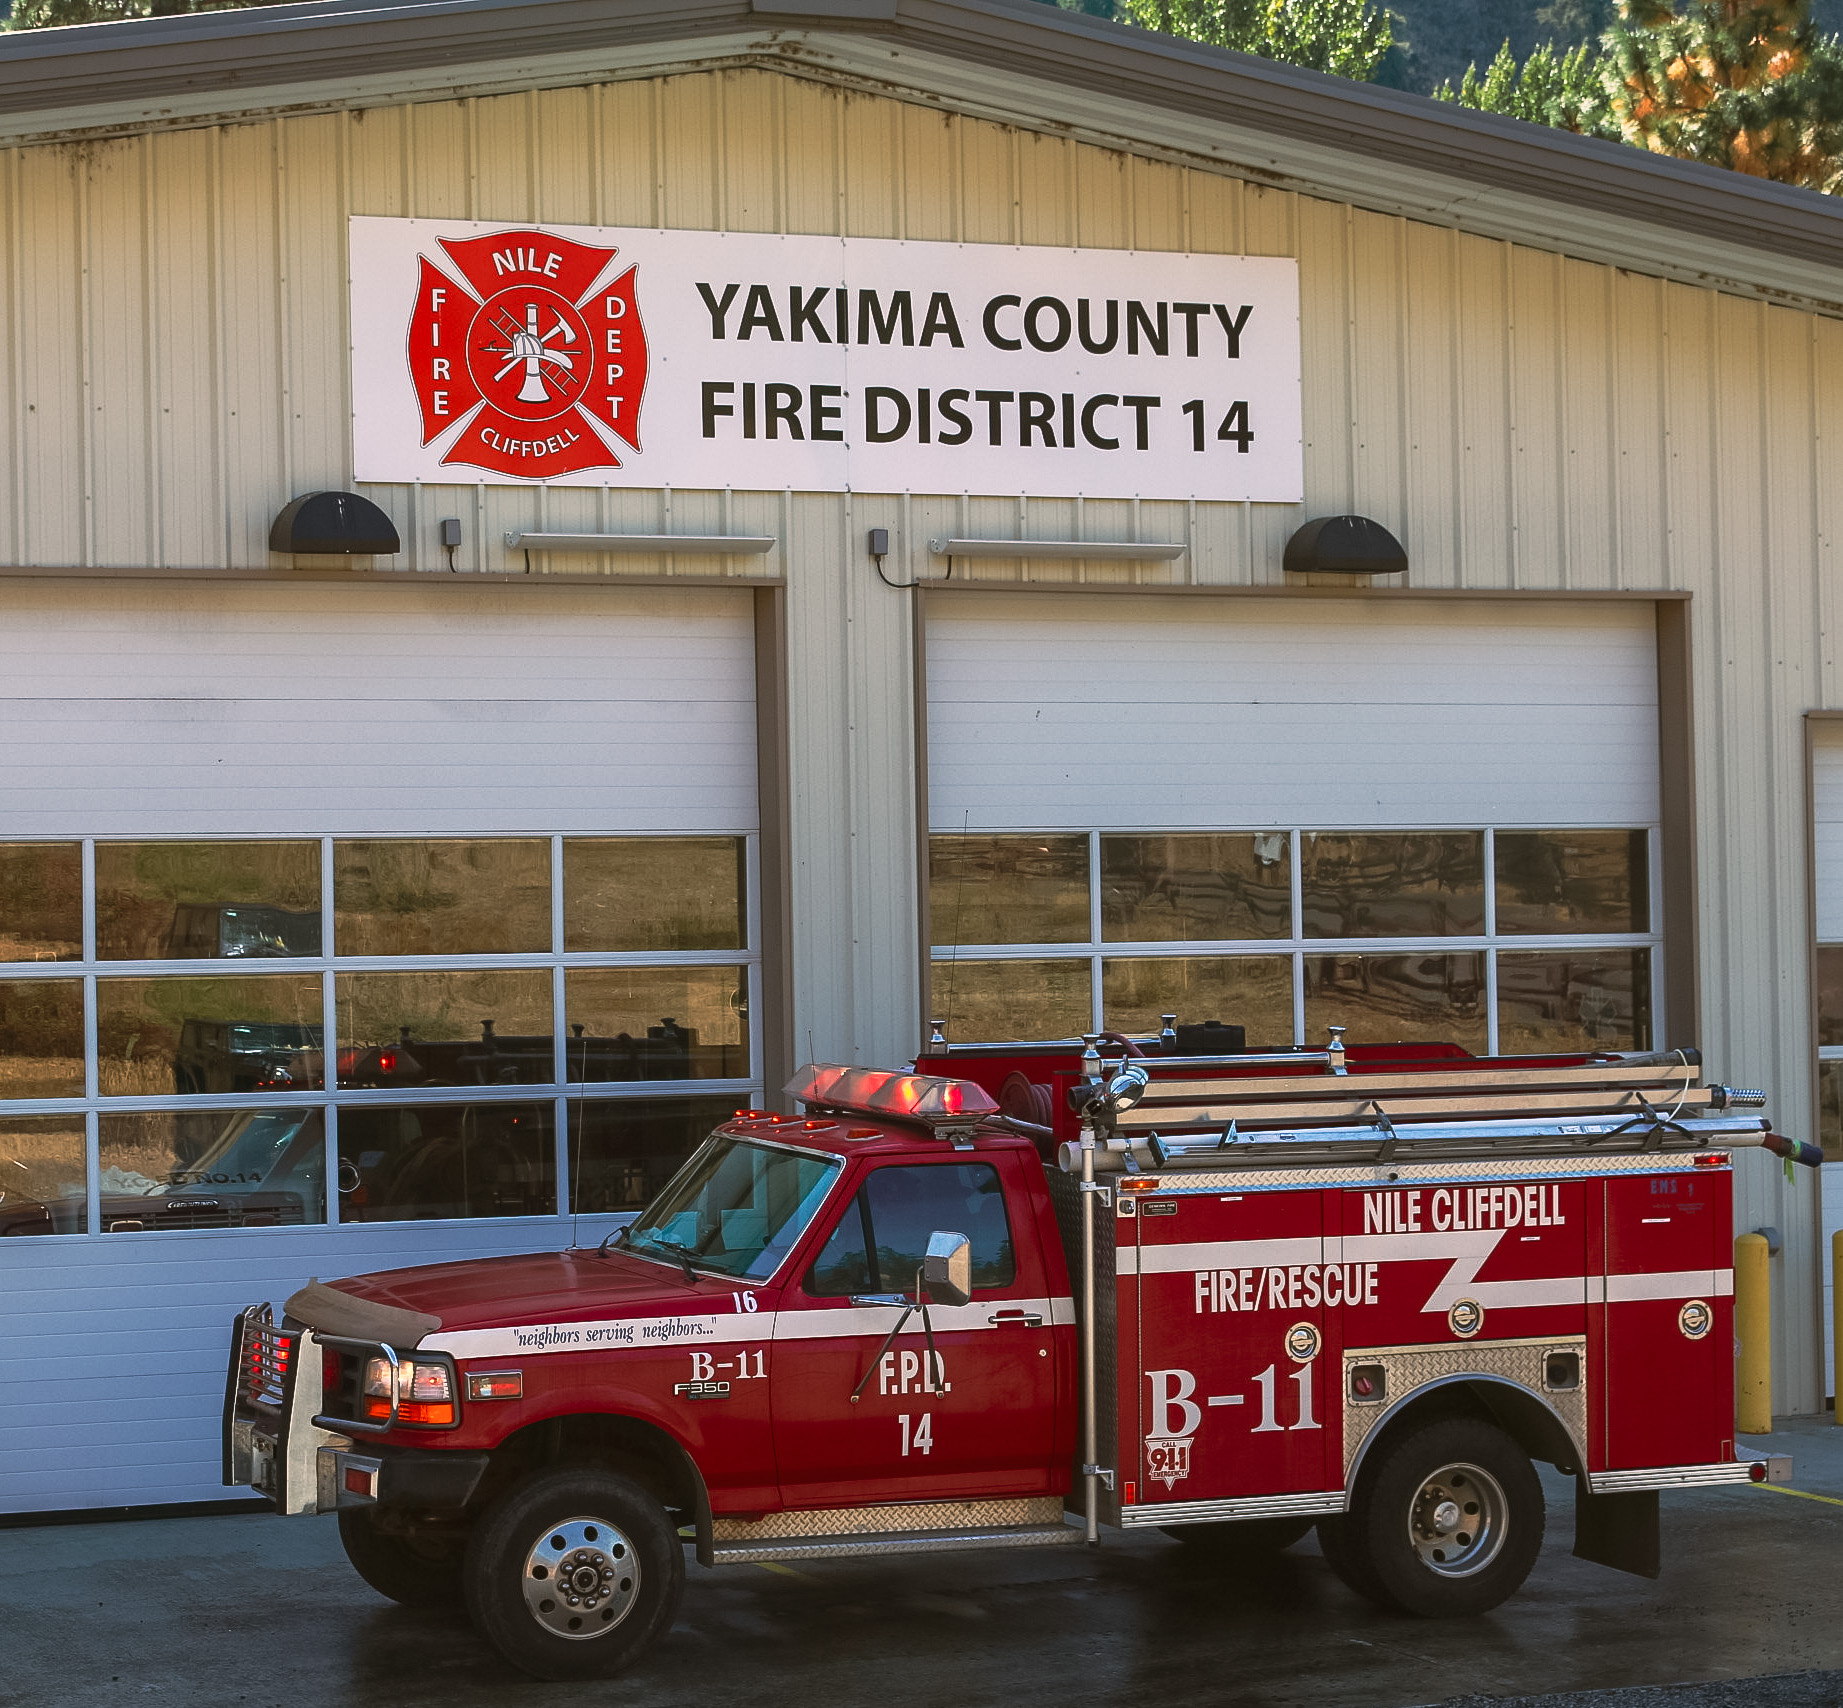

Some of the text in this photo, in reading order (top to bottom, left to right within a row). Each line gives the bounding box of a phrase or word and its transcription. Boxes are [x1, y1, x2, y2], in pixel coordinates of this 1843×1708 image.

[492, 247, 563, 279] NILE
[695, 282, 1253, 359] YAKIMA COUNTY
[431, 288, 451, 415] FIRE
[605, 296, 626, 419] DEPT
[701, 381, 1254, 453] FIRE DISTRICT 14
[480, 427, 580, 457] CLIFFDELL
[1364, 1185, 1565, 1234] NILE CLIFFDELL
[732, 1290, 758, 1313] 16
[1195, 1264, 1378, 1313] FIRE/RESCUE
[514, 1316, 717, 1349] "neighbors serving neighbors..."
[689, 1349, 768, 1381] B-11
[880, 1350, 951, 1395] F.P.D.
[1145, 1362, 1322, 1439] B-11
[899, 1413, 933, 1456] 14
